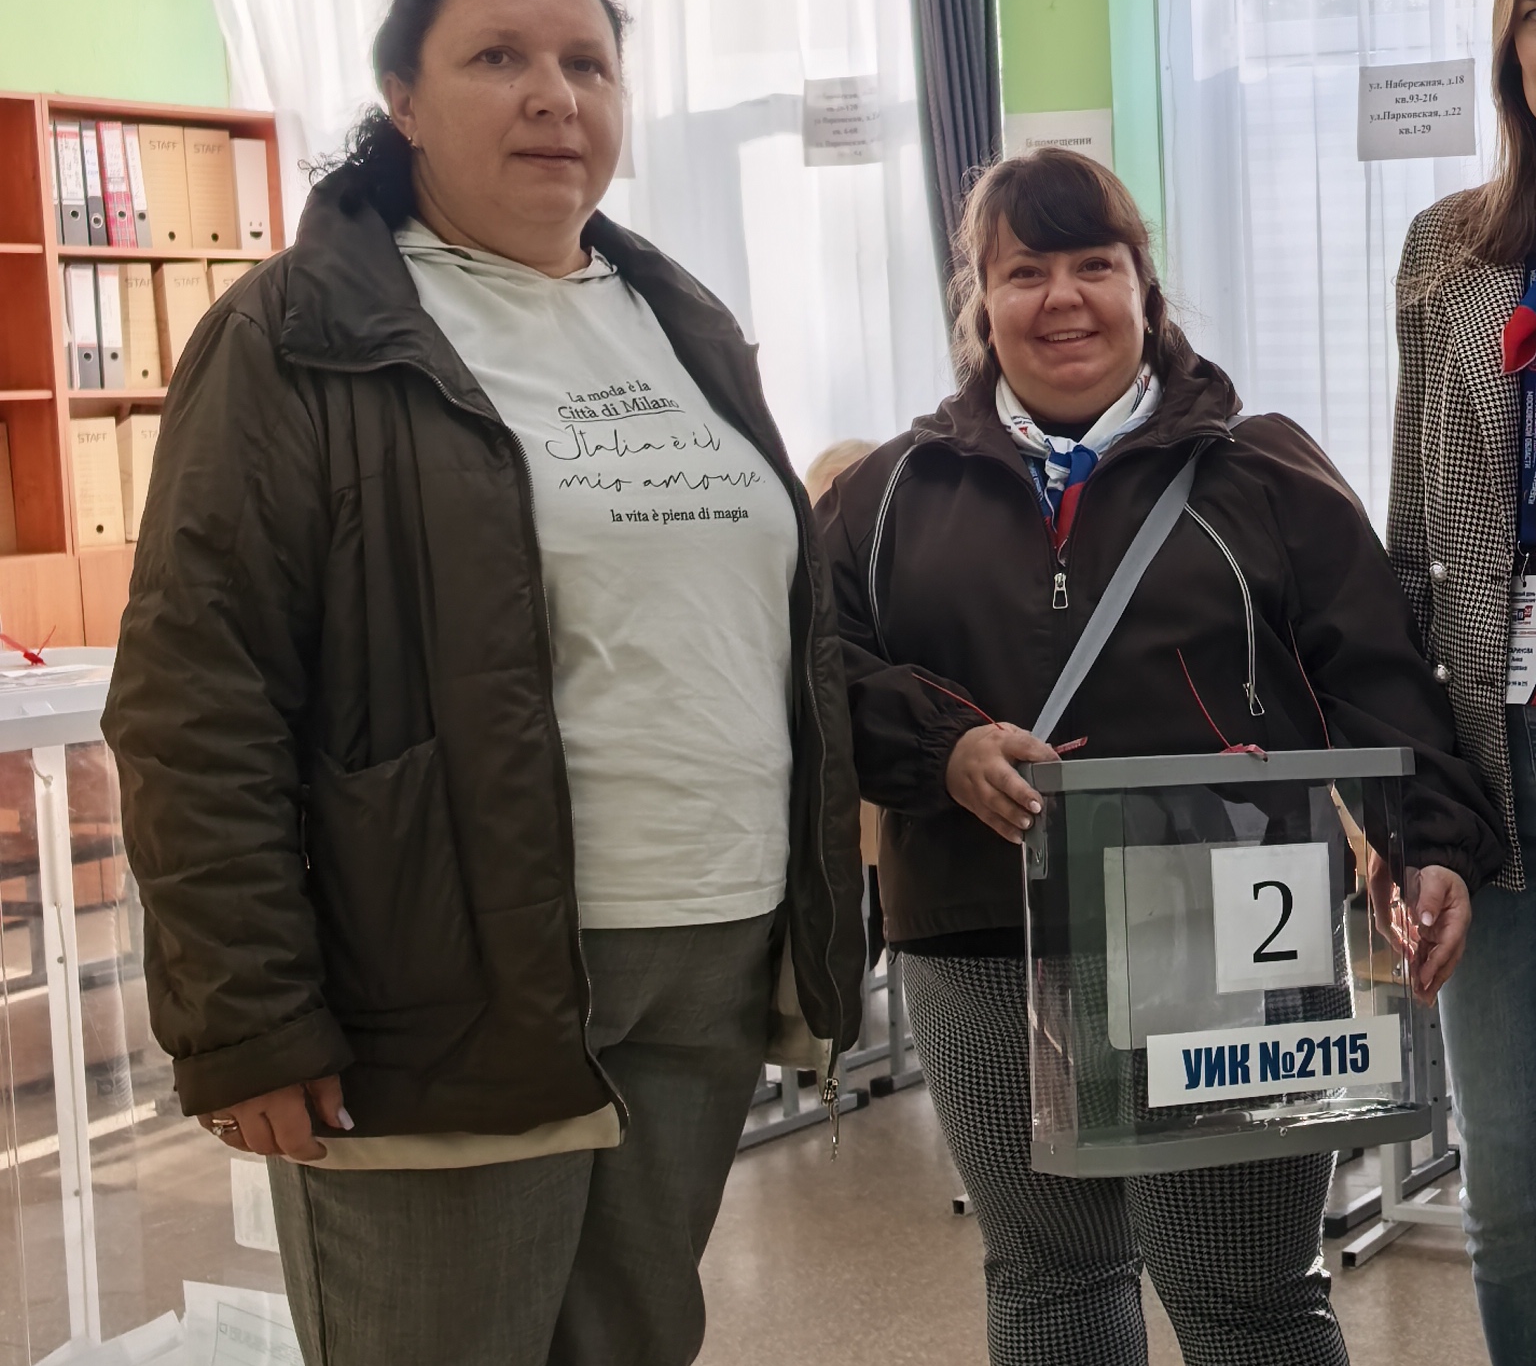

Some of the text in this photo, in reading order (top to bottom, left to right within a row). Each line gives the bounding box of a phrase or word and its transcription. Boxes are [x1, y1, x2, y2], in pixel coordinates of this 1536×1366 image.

[1368, 80, 1382, 92] ул.
[1385, 79, 1445, 91] Набережная,
[1395, 93, 1438, 105] кв.93-216
[1398, 124, 1432, 136] кв.1-29
[1034, 137, 1092, 147] помещении
[125, 277, 152, 289] STAF
[567, 379, 652, 404] La moda è la
[558, 396, 680, 421] Città di Milano
[559, 472, 633, 493] mio
[611, 506, 749, 525] la vita è piena di magia
[1252, 880, 1298, 963] 2
[1182, 1033, 1370, 1091] УИК №2115
